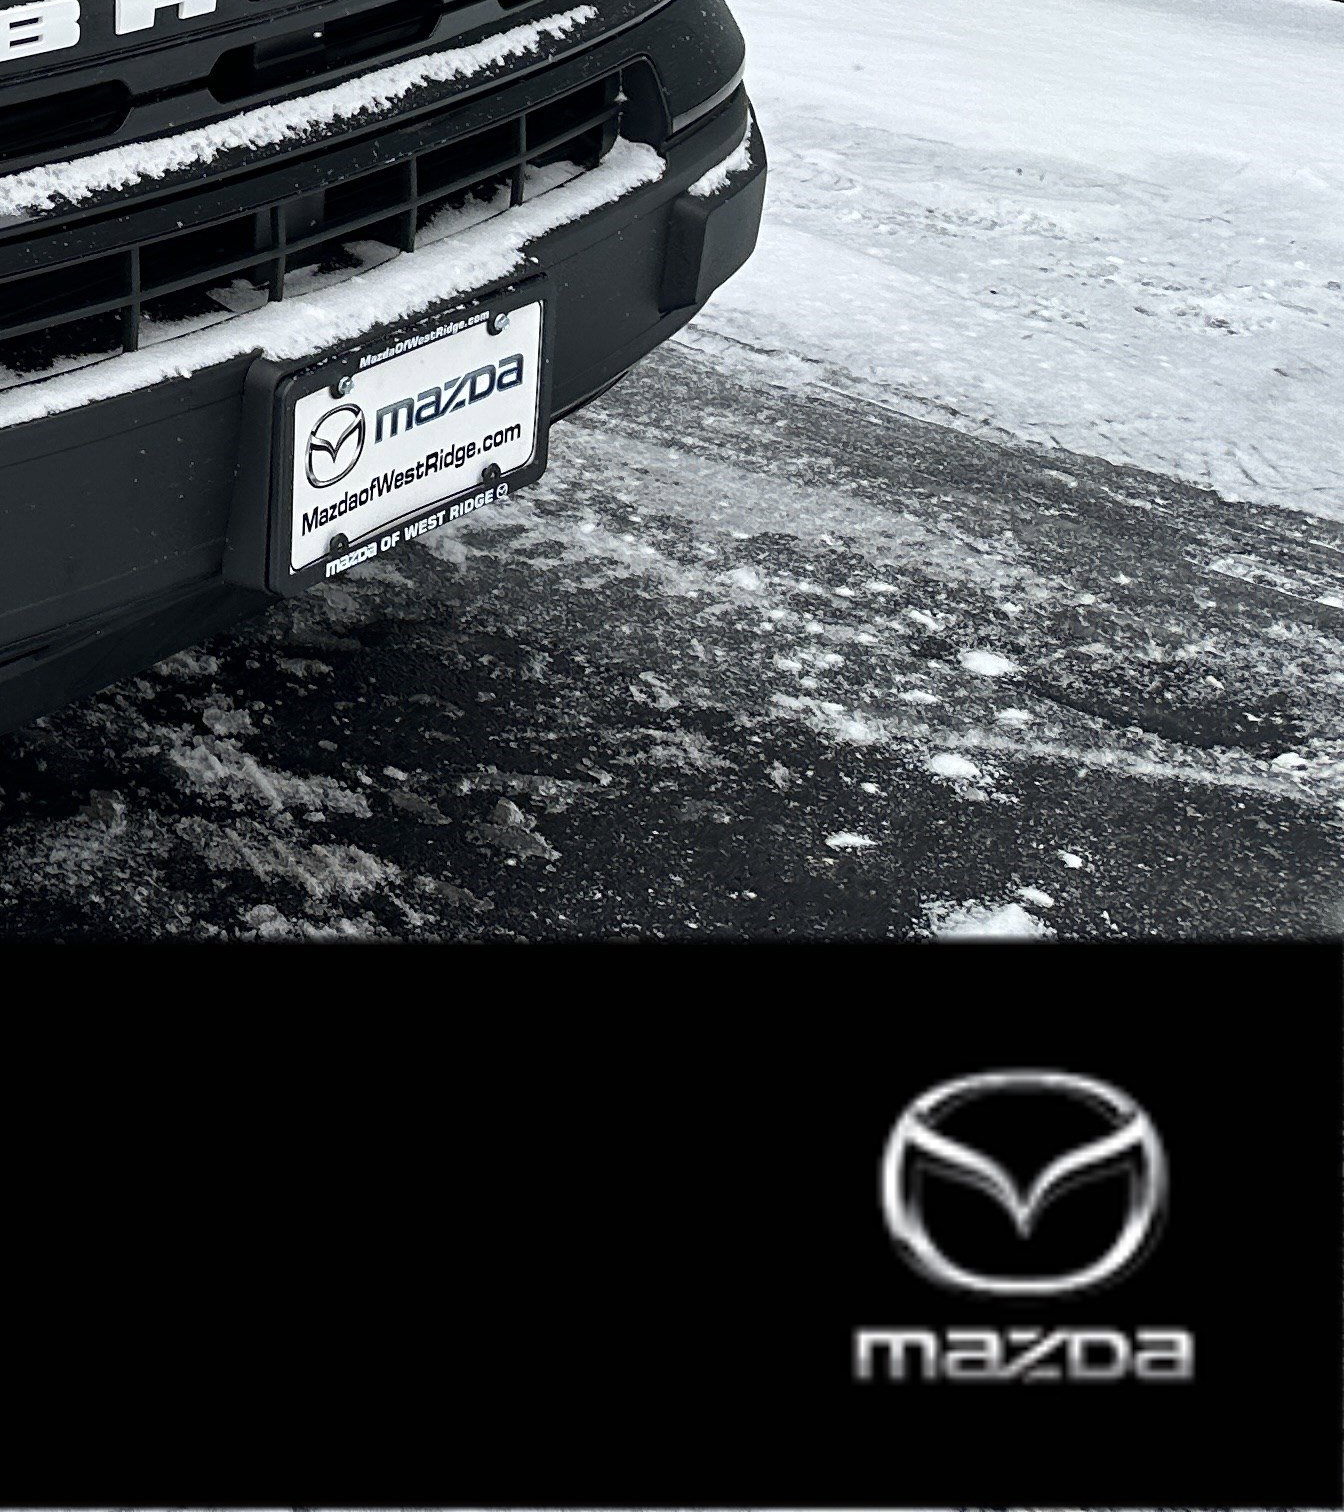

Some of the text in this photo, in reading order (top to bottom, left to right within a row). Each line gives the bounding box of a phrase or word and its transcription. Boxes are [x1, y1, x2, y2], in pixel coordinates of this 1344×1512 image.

[301, 423, 522, 537] MazdaofWestRidge.com
[380, 531, 401, 554] OF
[404, 510, 446, 540] WEST
[449, 489, 495, 522] RIDGE
